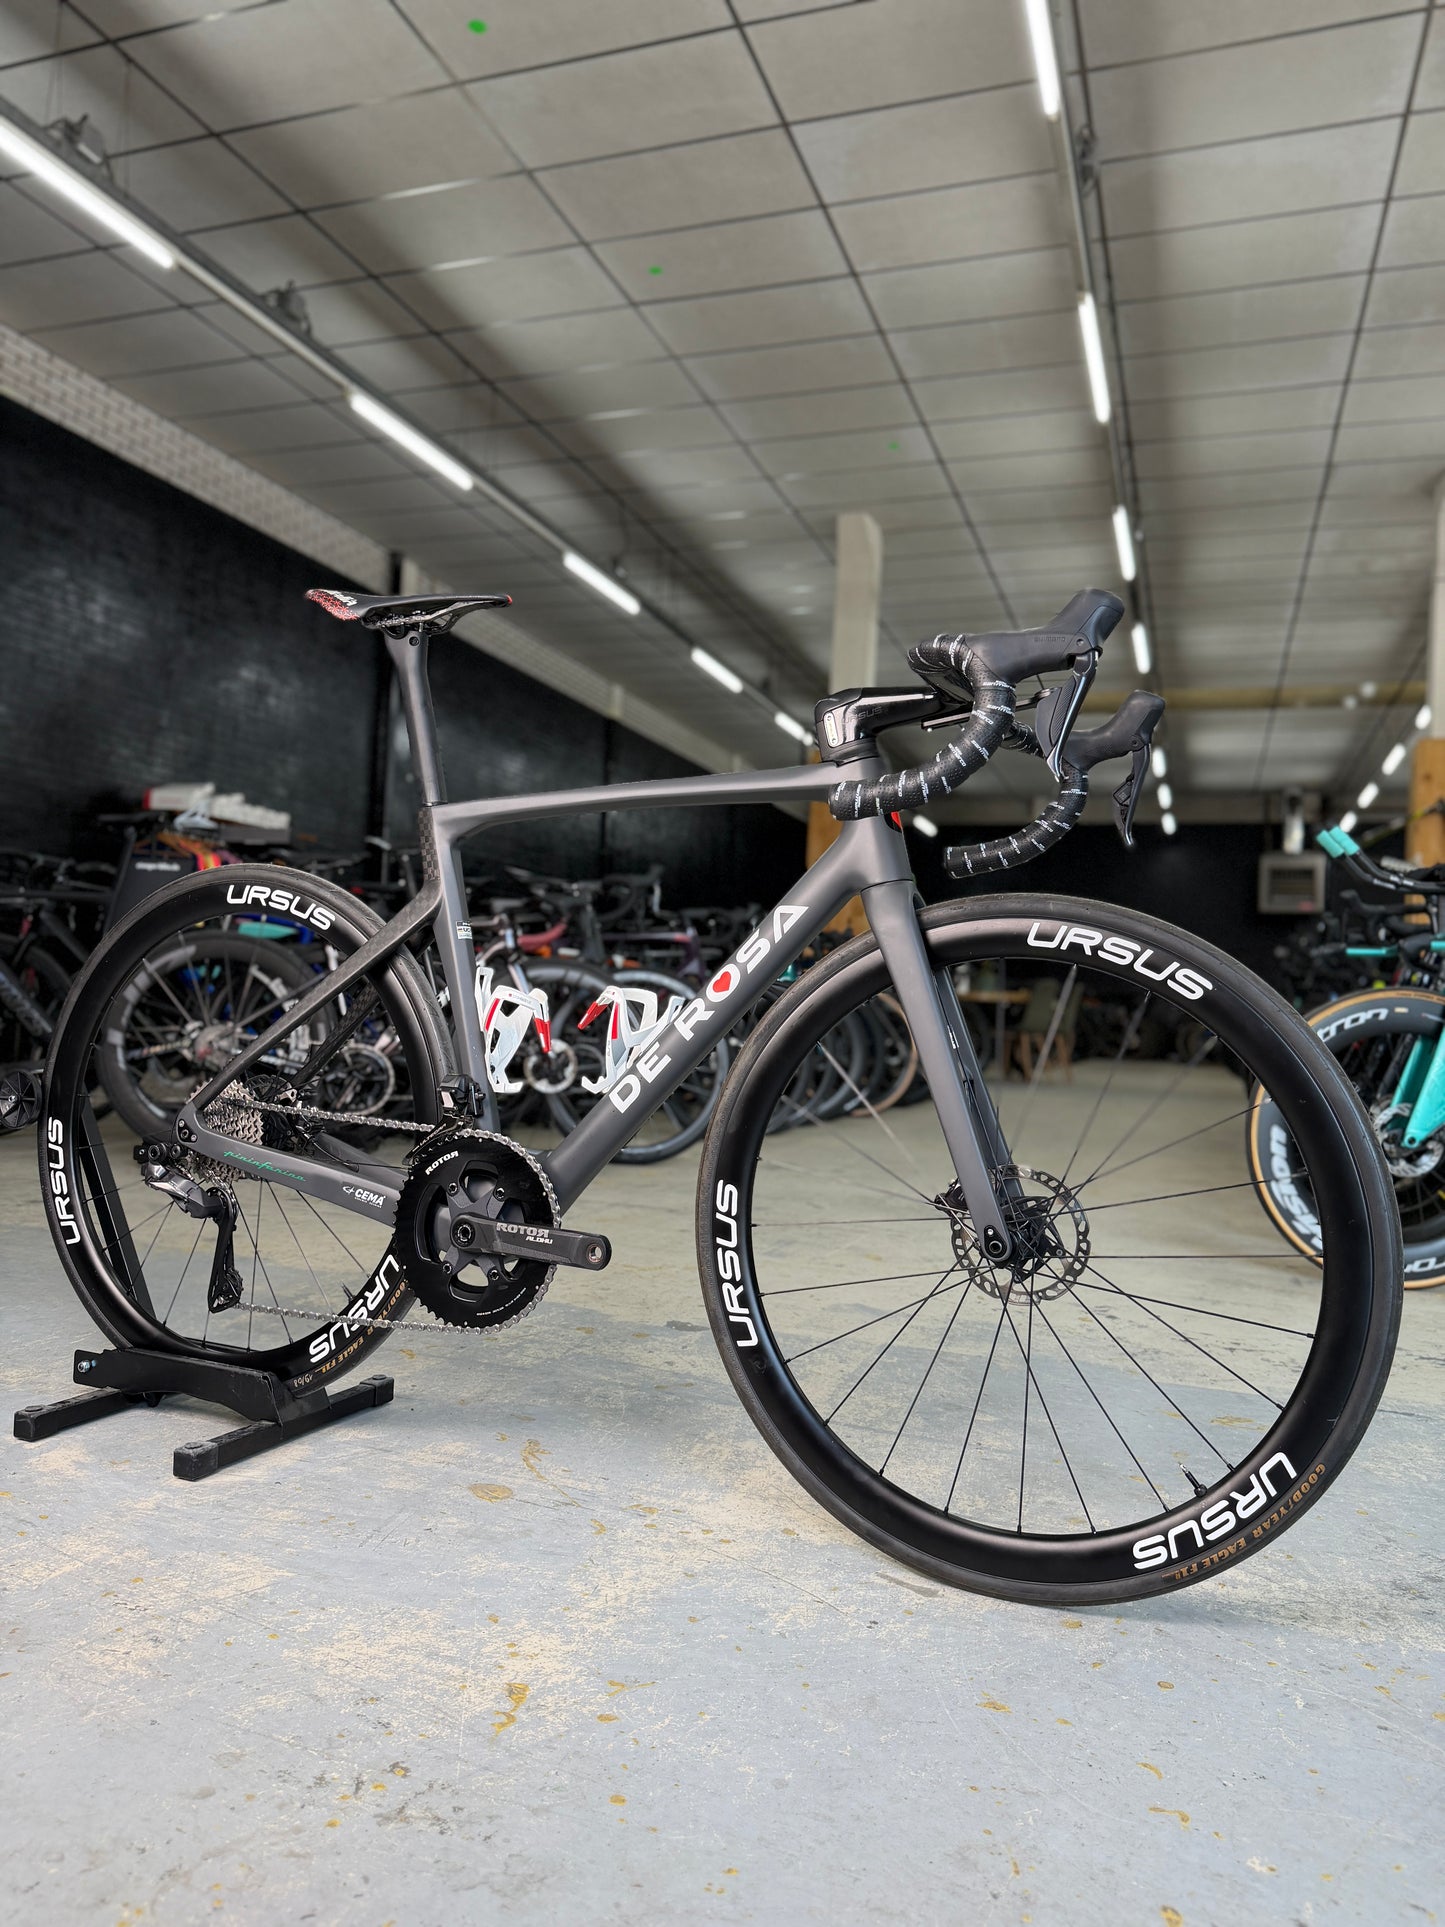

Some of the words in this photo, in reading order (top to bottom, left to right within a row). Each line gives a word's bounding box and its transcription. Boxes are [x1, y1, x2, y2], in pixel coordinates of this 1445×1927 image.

[226, 884, 336, 930] URSUS
[1027, 922, 1214, 1001] URSUS
[608, 1041, 672, 1114] DE
[673, 904, 811, 1041] ROSA
[1315, 1007, 1389, 1044] tron
[48, 1116, 81, 1245] URSUS
[223, 1151, 306, 1182] pininfarina
[424, 1150, 459, 1176] ROTOR
[354, 1188, 385, 1206] CEMA
[496, 1222, 550, 1238] ROTOR
[715, 1179, 759, 1347] URSUS
[309, 1254, 400, 1363] URSUS
[1132, 1452, 1297, 1570] URSUS
[1201, 1537, 1247, 1568] EAGLE
